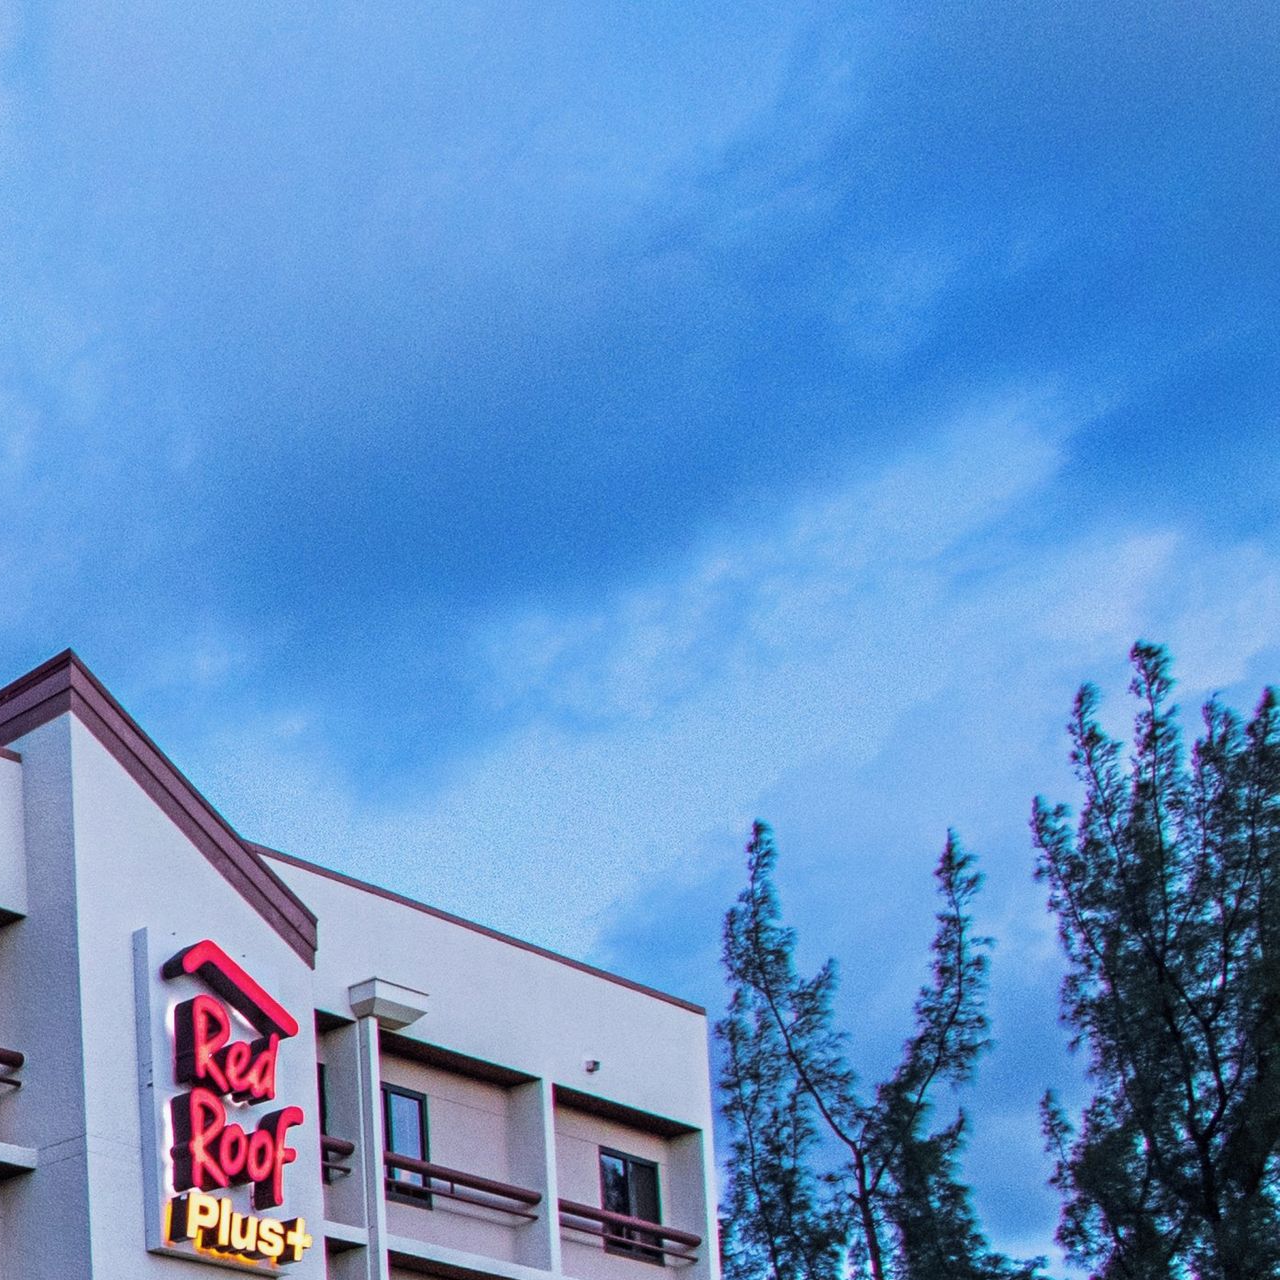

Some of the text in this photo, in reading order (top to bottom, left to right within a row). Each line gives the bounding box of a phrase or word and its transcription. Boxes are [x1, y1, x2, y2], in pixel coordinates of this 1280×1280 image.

[191, 994, 280, 1100] Red
[190, 1086, 304, 1206] Roof
[186, 1190, 313, 1261] Plus+
